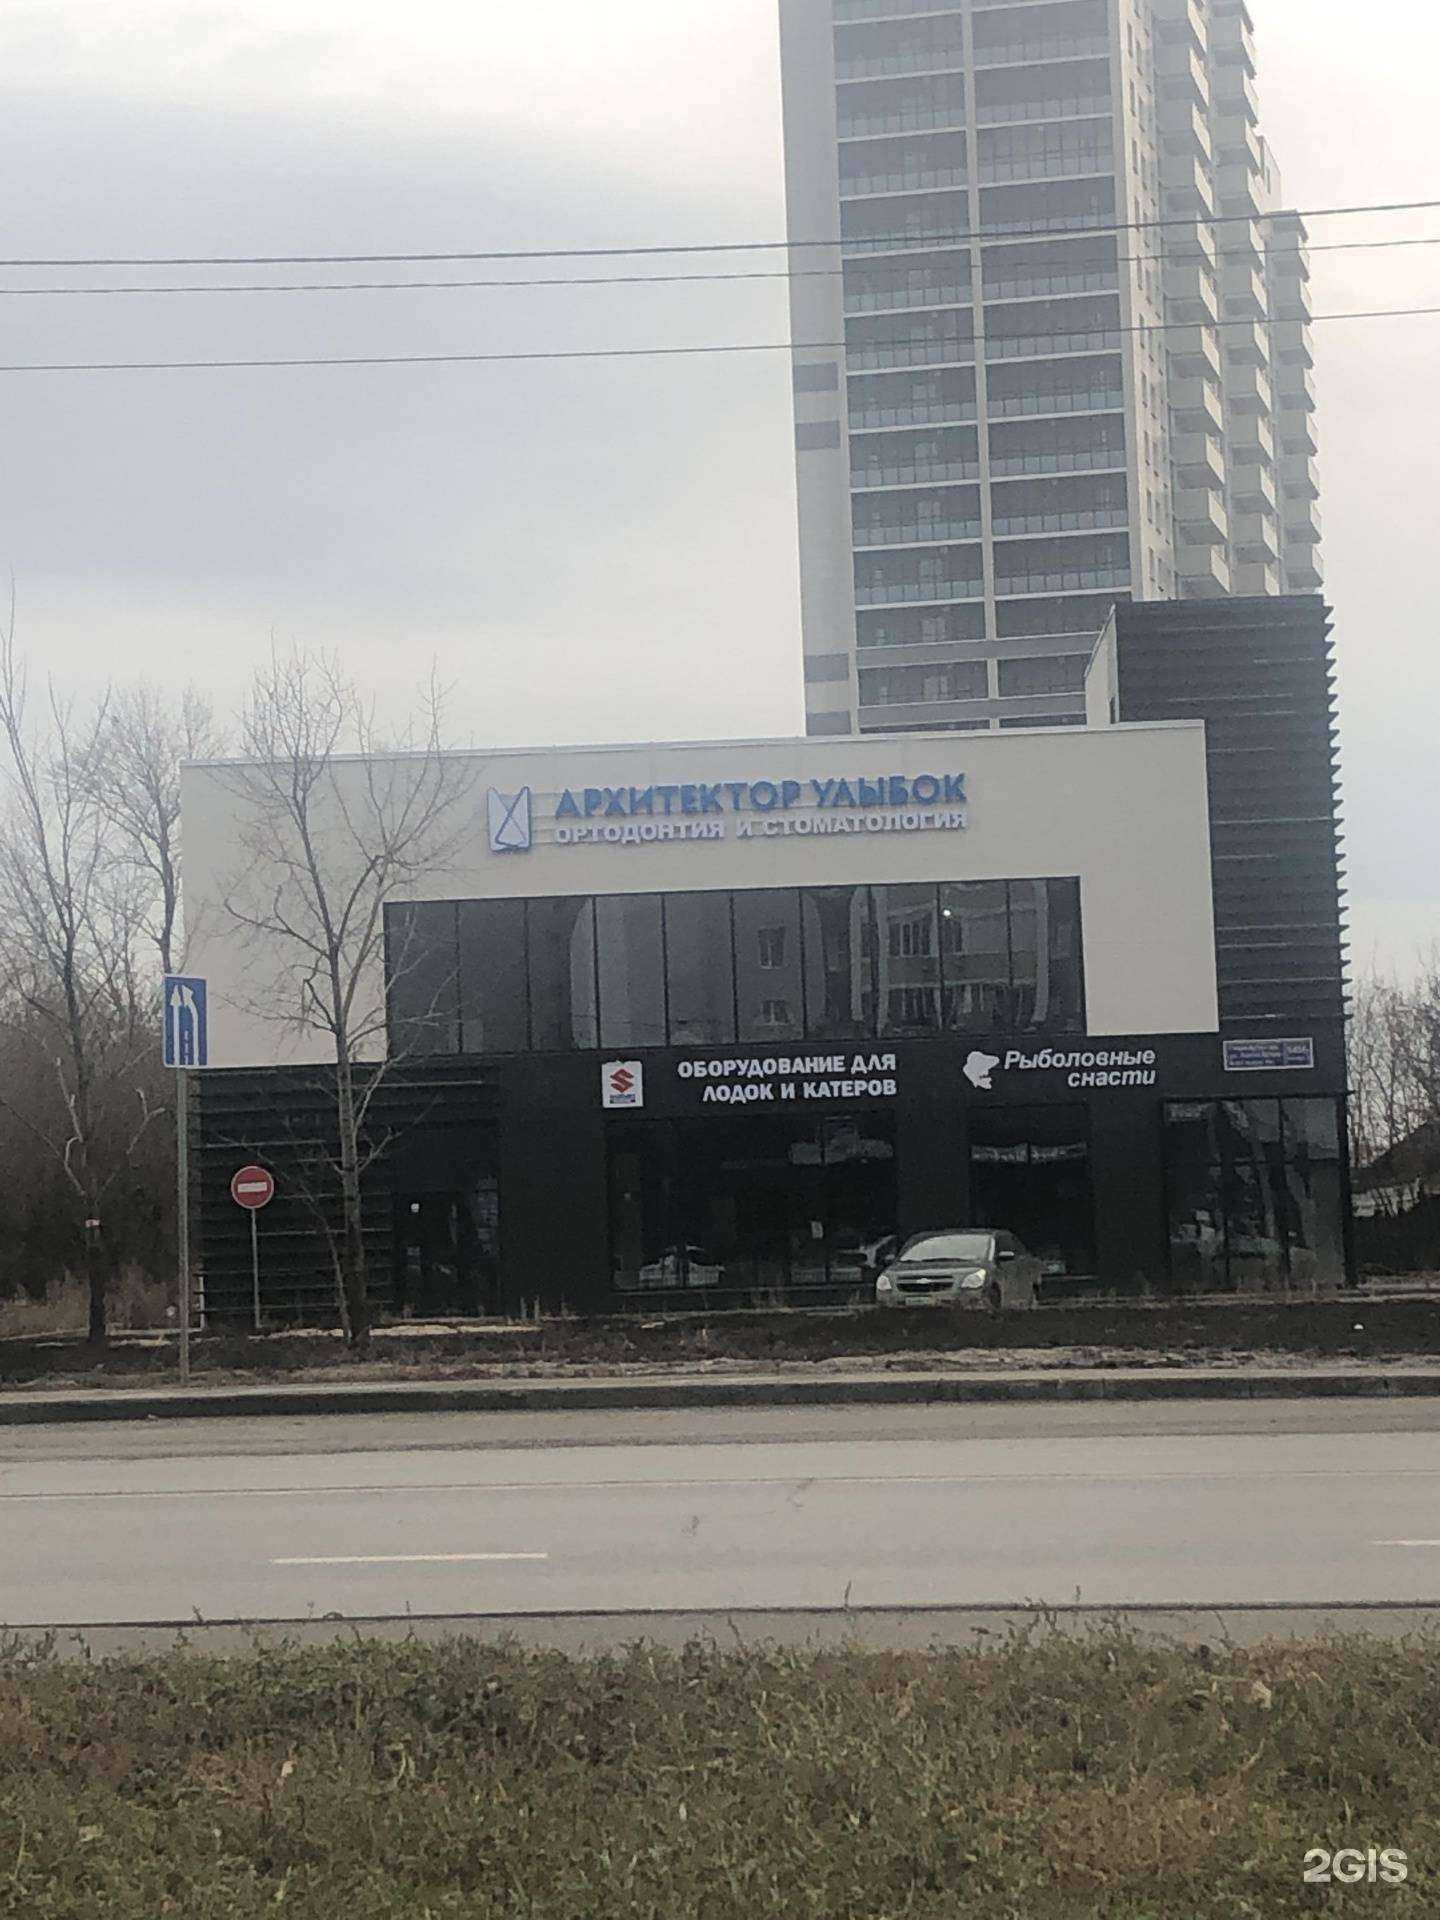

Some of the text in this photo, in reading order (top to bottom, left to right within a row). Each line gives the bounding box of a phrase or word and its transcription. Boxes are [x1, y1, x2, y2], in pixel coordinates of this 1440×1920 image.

[555, 773, 968, 820] АРХИТЕКТОР УЛЫБОК
[555, 812, 969, 845] ОРТОДОНТИЯ И СТОМАТОЛОГИЯ
[677, 1053, 897, 1079] ОБОРУДОВАНИЕ ДЛЯ
[1004, 1049, 1156, 1070] Рыболовные
[702, 1078, 898, 1104] ЛОДОК И КАТЕРОВ
[1067, 1069, 1156, 1088] снасти
